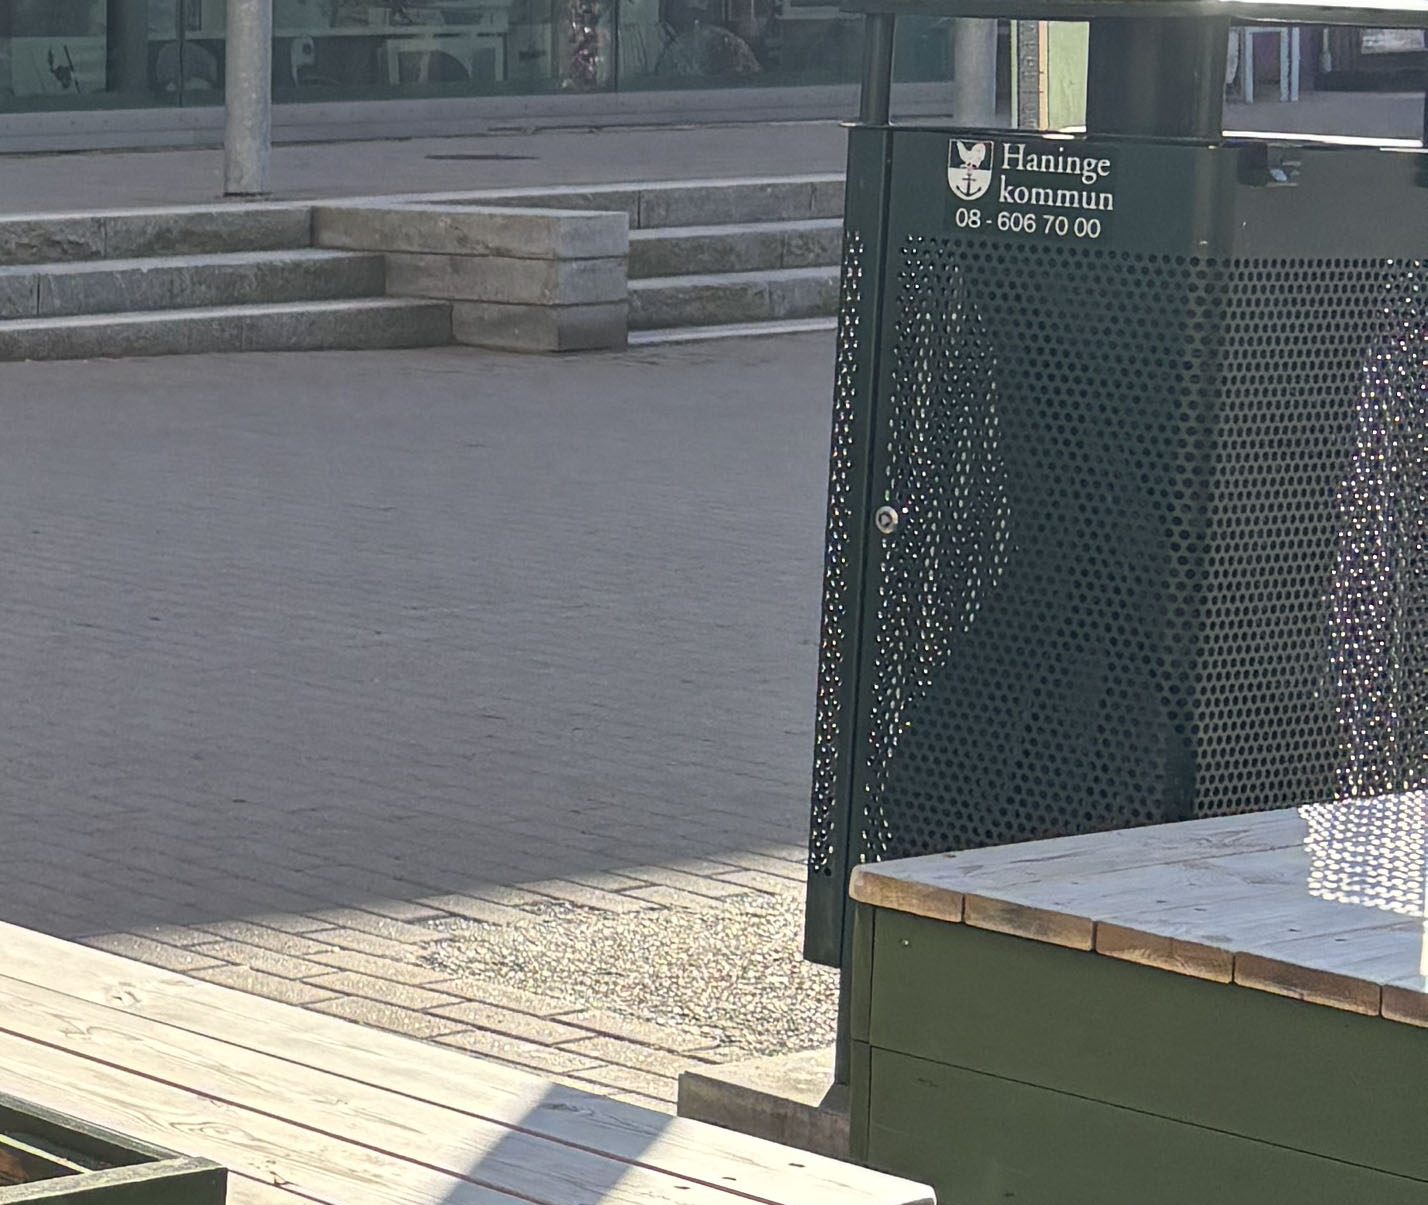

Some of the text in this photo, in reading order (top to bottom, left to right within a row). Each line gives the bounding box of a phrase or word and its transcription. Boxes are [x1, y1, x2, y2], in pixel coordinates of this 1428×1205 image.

[1001, 143, 1111, 184] Haninge
[999, 175, 1114, 210] kommun
[1043, 215, 1068, 235] 70
[1074, 217, 1101, 238] 00
